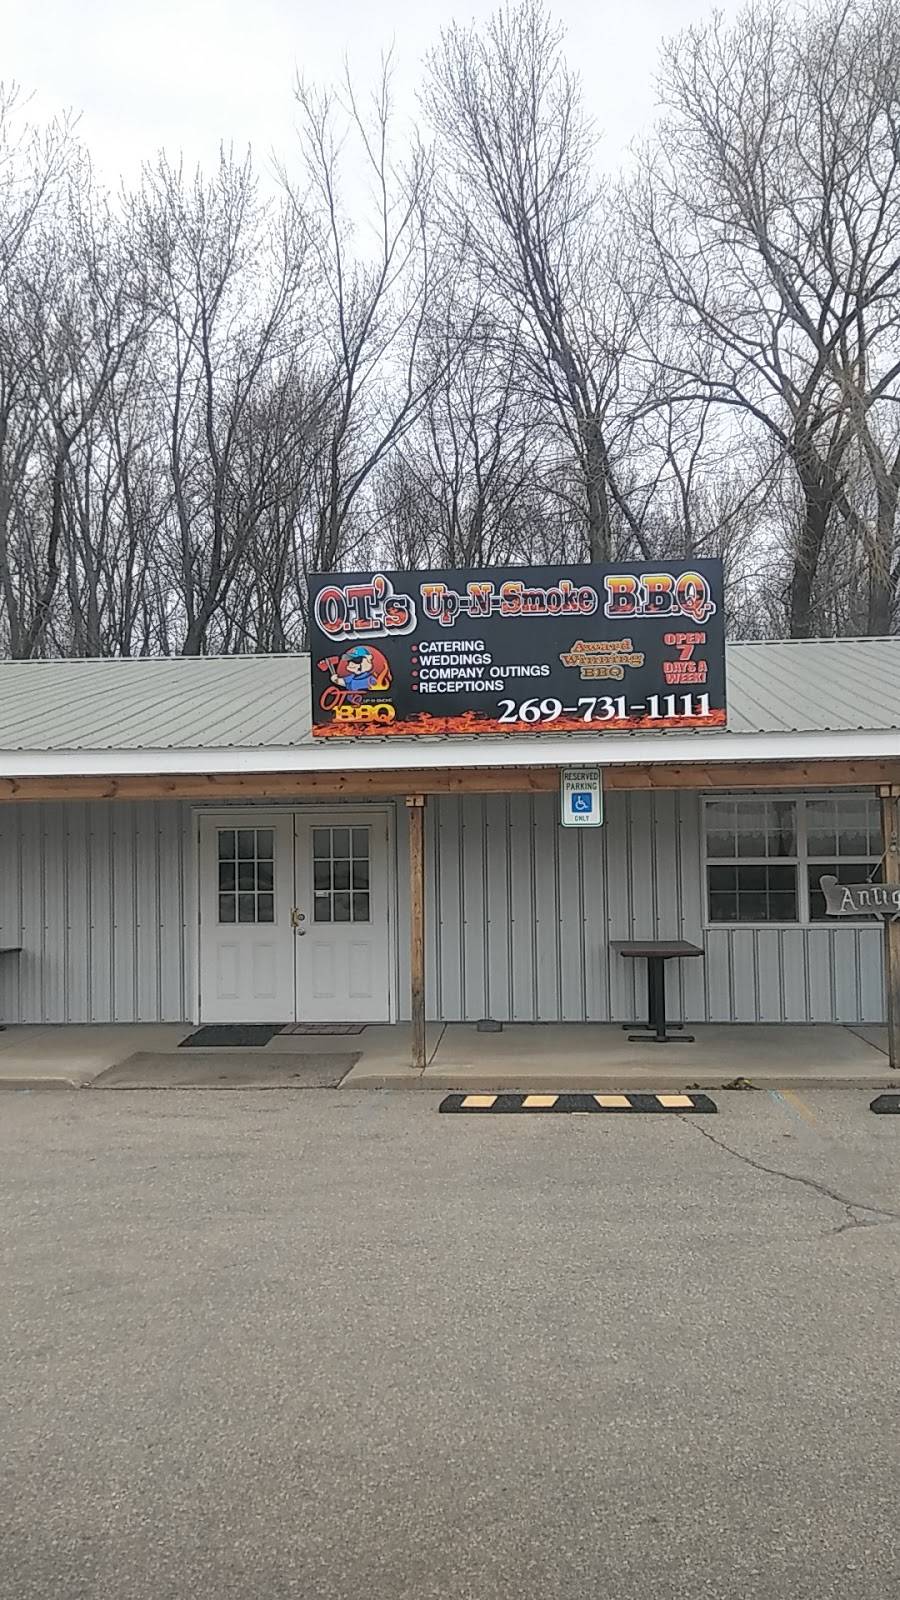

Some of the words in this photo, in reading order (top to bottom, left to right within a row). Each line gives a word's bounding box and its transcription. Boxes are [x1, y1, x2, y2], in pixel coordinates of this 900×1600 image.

[421, 582, 597, 625] Up-N-Smoke
[664, 632, 706, 645] OPEN
[419, 640, 485, 653] CATERING
[572, 639, 632, 653] Award
[676, 644, 695, 660] 7
[419, 653, 492, 666] WEDDINGS
[560, 653, 644, 667] Winning
[419, 667, 484, 680] COMPANY
[489, 665, 550, 678] OUTINGS
[663, 661, 697, 673] DAYS
[698, 660, 708, 673] A
[666, 672, 707, 684] WEEK!
[419, 680, 504, 693] RECEPTIONS
[332, 704, 396, 725] BBQ
[497, 693, 713, 723] 269-731-1111
[564, 772, 599, 781] RESERVED
[566, 782, 598, 791] PARKING
